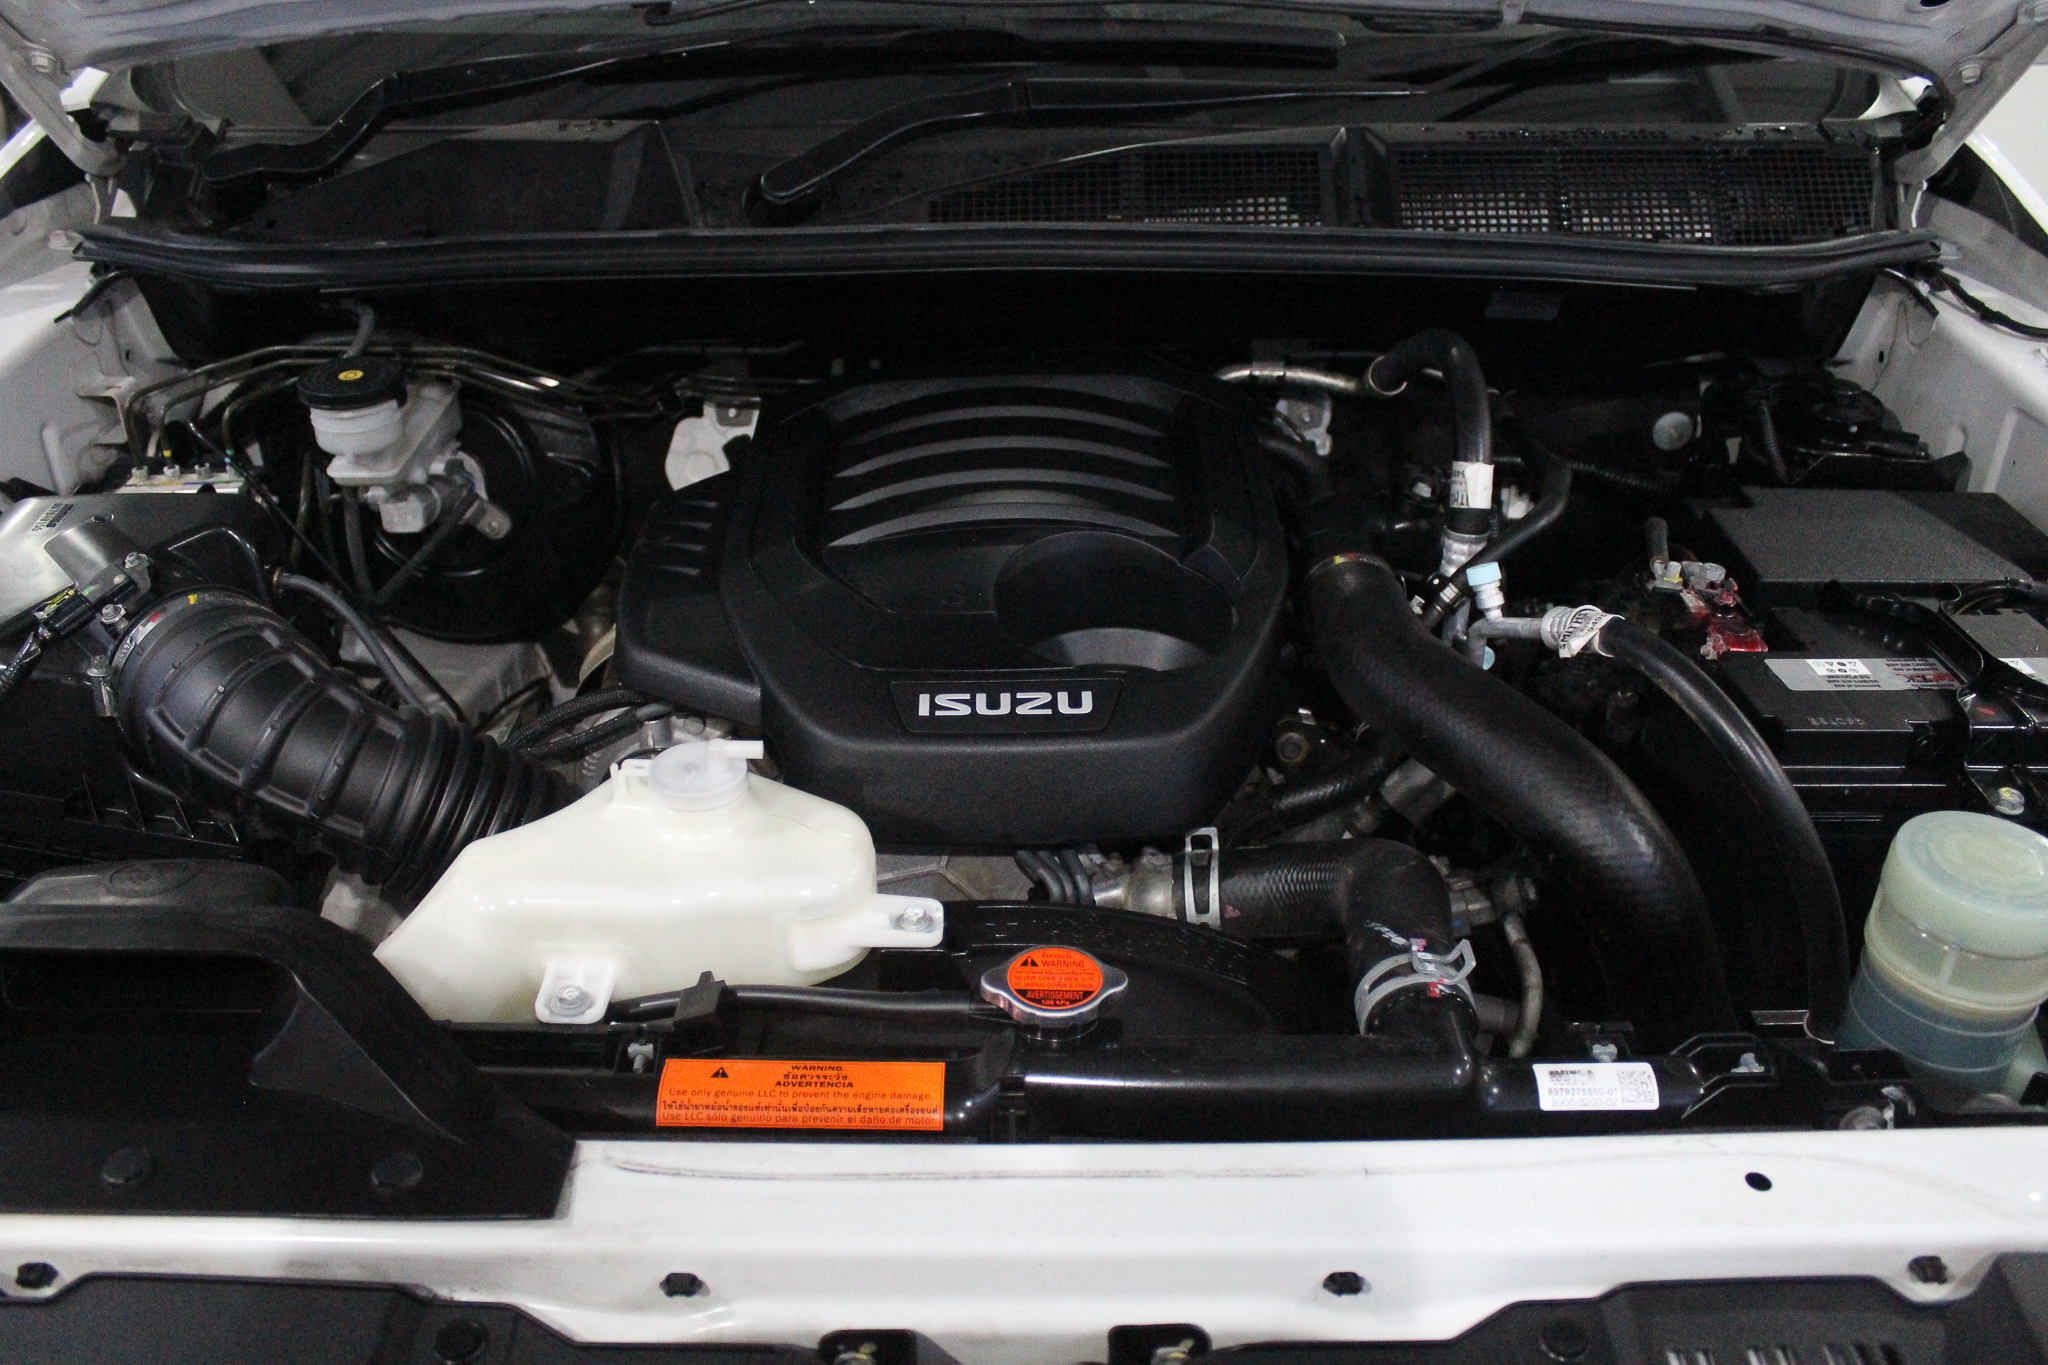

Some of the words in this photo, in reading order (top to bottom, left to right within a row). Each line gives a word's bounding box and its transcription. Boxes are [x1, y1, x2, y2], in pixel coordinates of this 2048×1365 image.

[918, 690, 1093, 717] ISUZU
[1041, 960, 1085, 968] WARNING
[1026, 990, 1084, 1000] AVERTISSEMENT
[774, 1080, 854, 1089] ADVERTENCIA
[669, 1088, 688, 1097] Use
[691, 1088, 712, 1099] only
[714, 1089, 754, 1099] genuine
[757, 1089, 777, 1098] LLC
[779, 1090, 789, 1098] to
[792, 1091, 830, 1100] prevent
[833, 1090, 849, 1099] the
[852, 1091, 887, 1101] engine
[661, 1111, 681, 1121] Use
[684, 1111, 704, 1121] LLC
[730, 1113, 772, 1123] genuino
[775, 1114, 798, 1123] para
[801, 1113, 844, 1124] prevenir
[860, 1114, 886, 1125] daño
[888, 1115, 902, 1125] de
[905, 1116, 938, 1126] motor.
